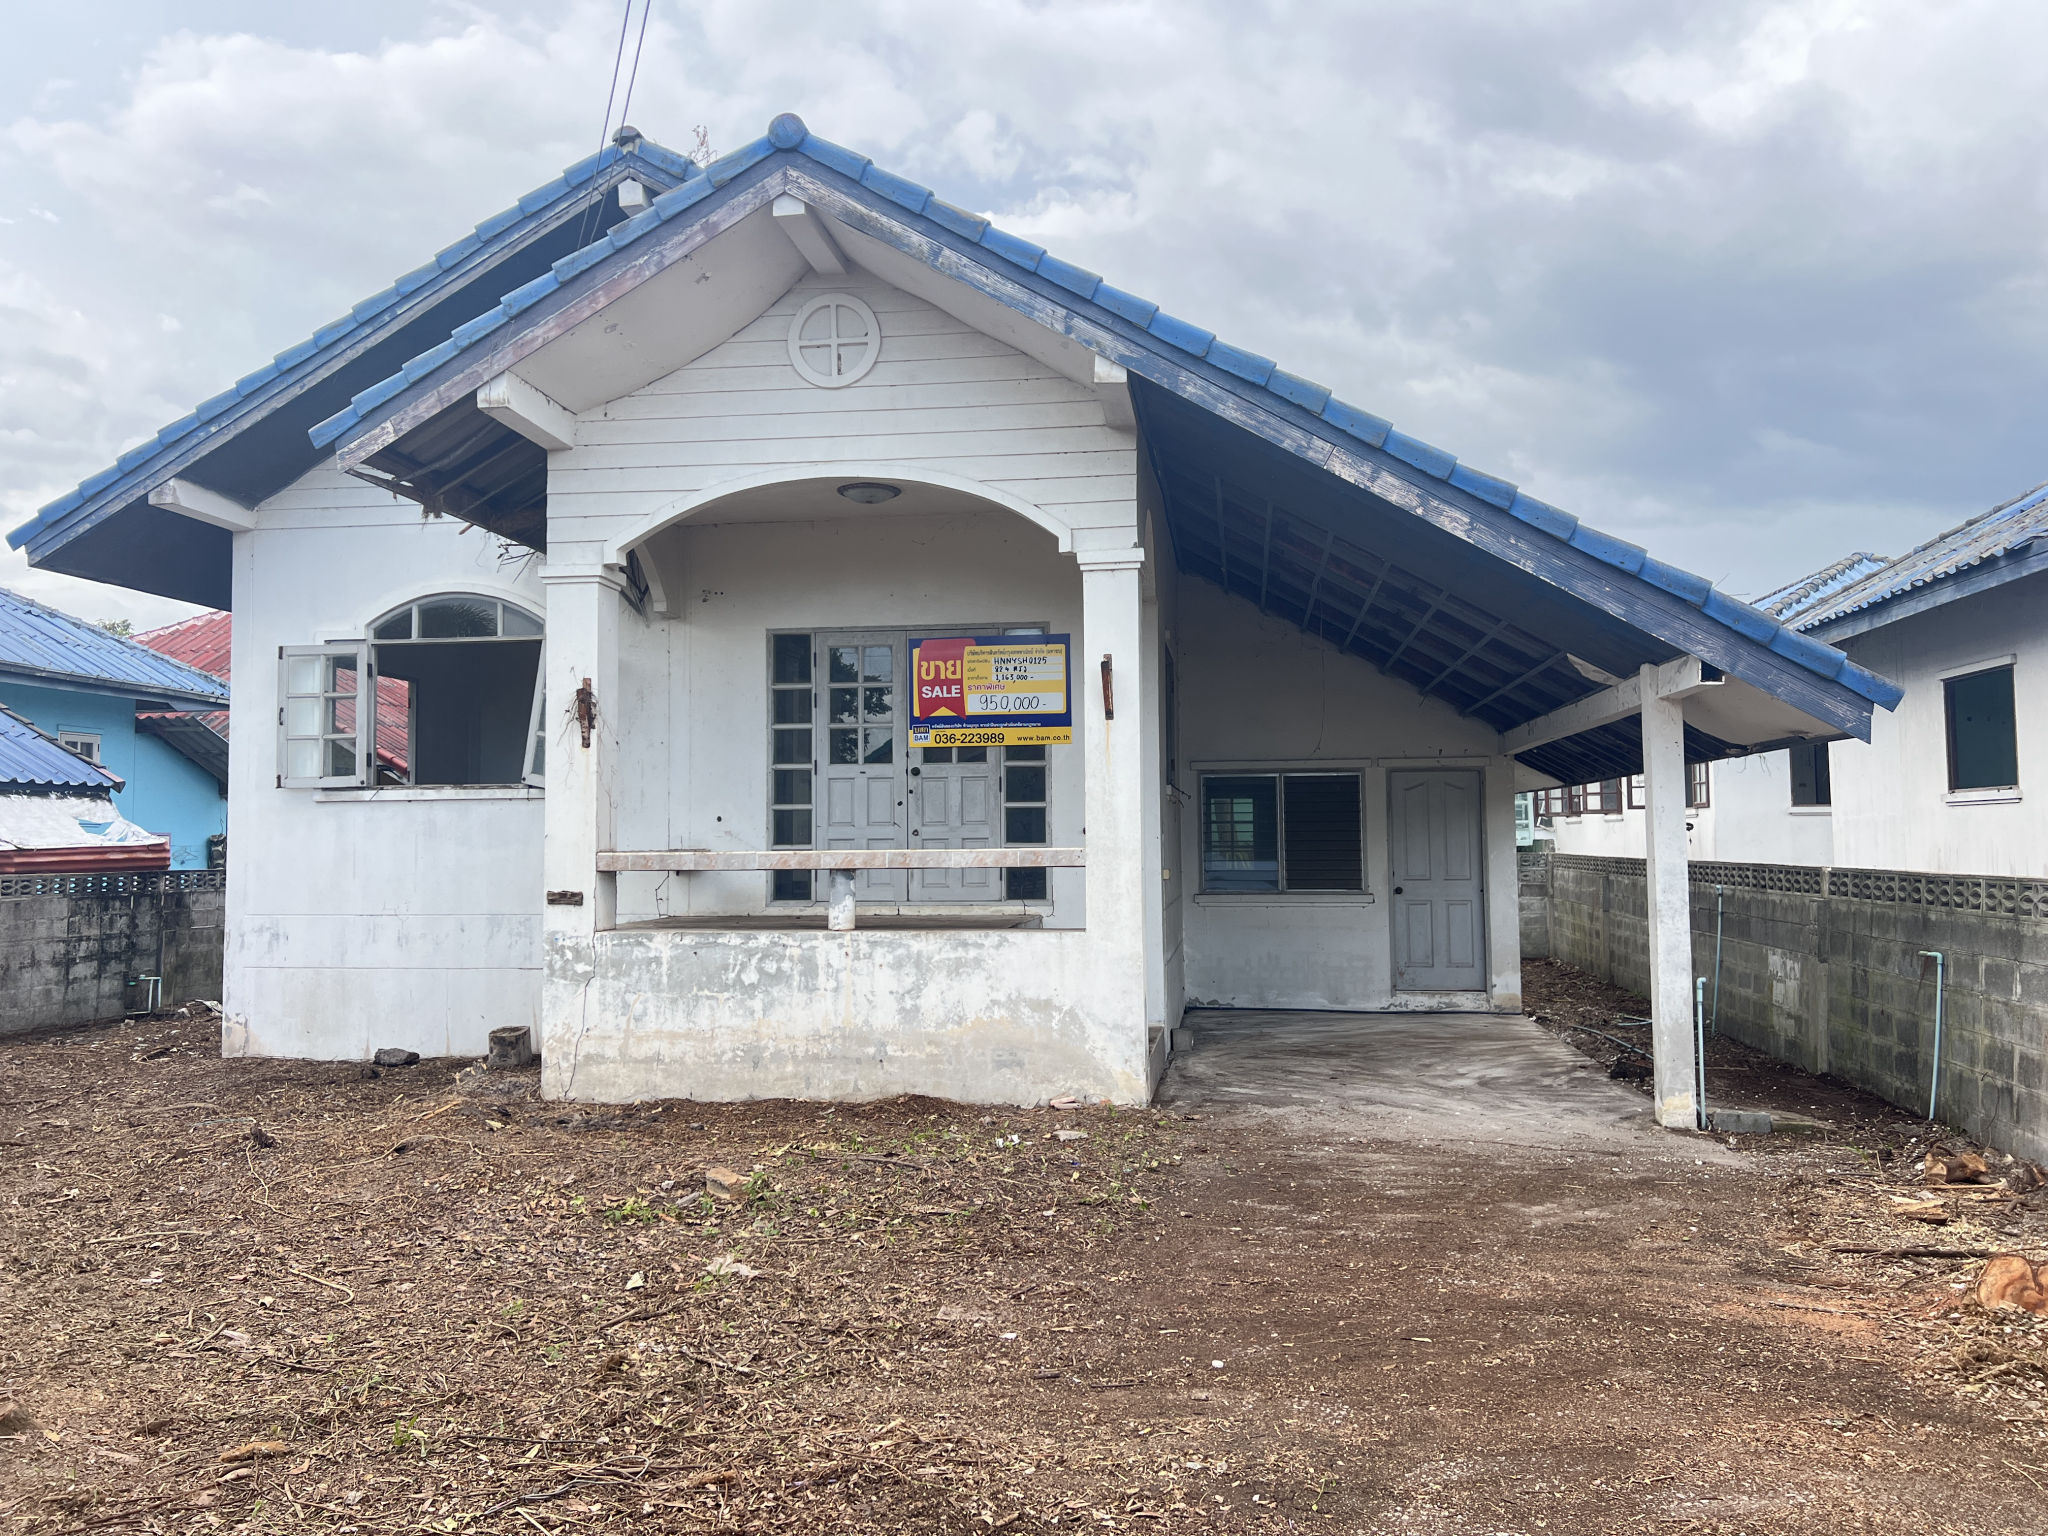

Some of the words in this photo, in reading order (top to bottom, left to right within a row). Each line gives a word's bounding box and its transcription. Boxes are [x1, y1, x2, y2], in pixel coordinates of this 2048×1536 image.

[921, 660, 962, 680] ขาย
[921, 685, 961, 698] SALE
[967, 683, 1006, 691] ราคาพิเศษ
[914, 734, 929, 742] BAM
[934, 732, 1005, 744] 036-223989
[1017, 734, 1070, 742] www.bam.co.th
